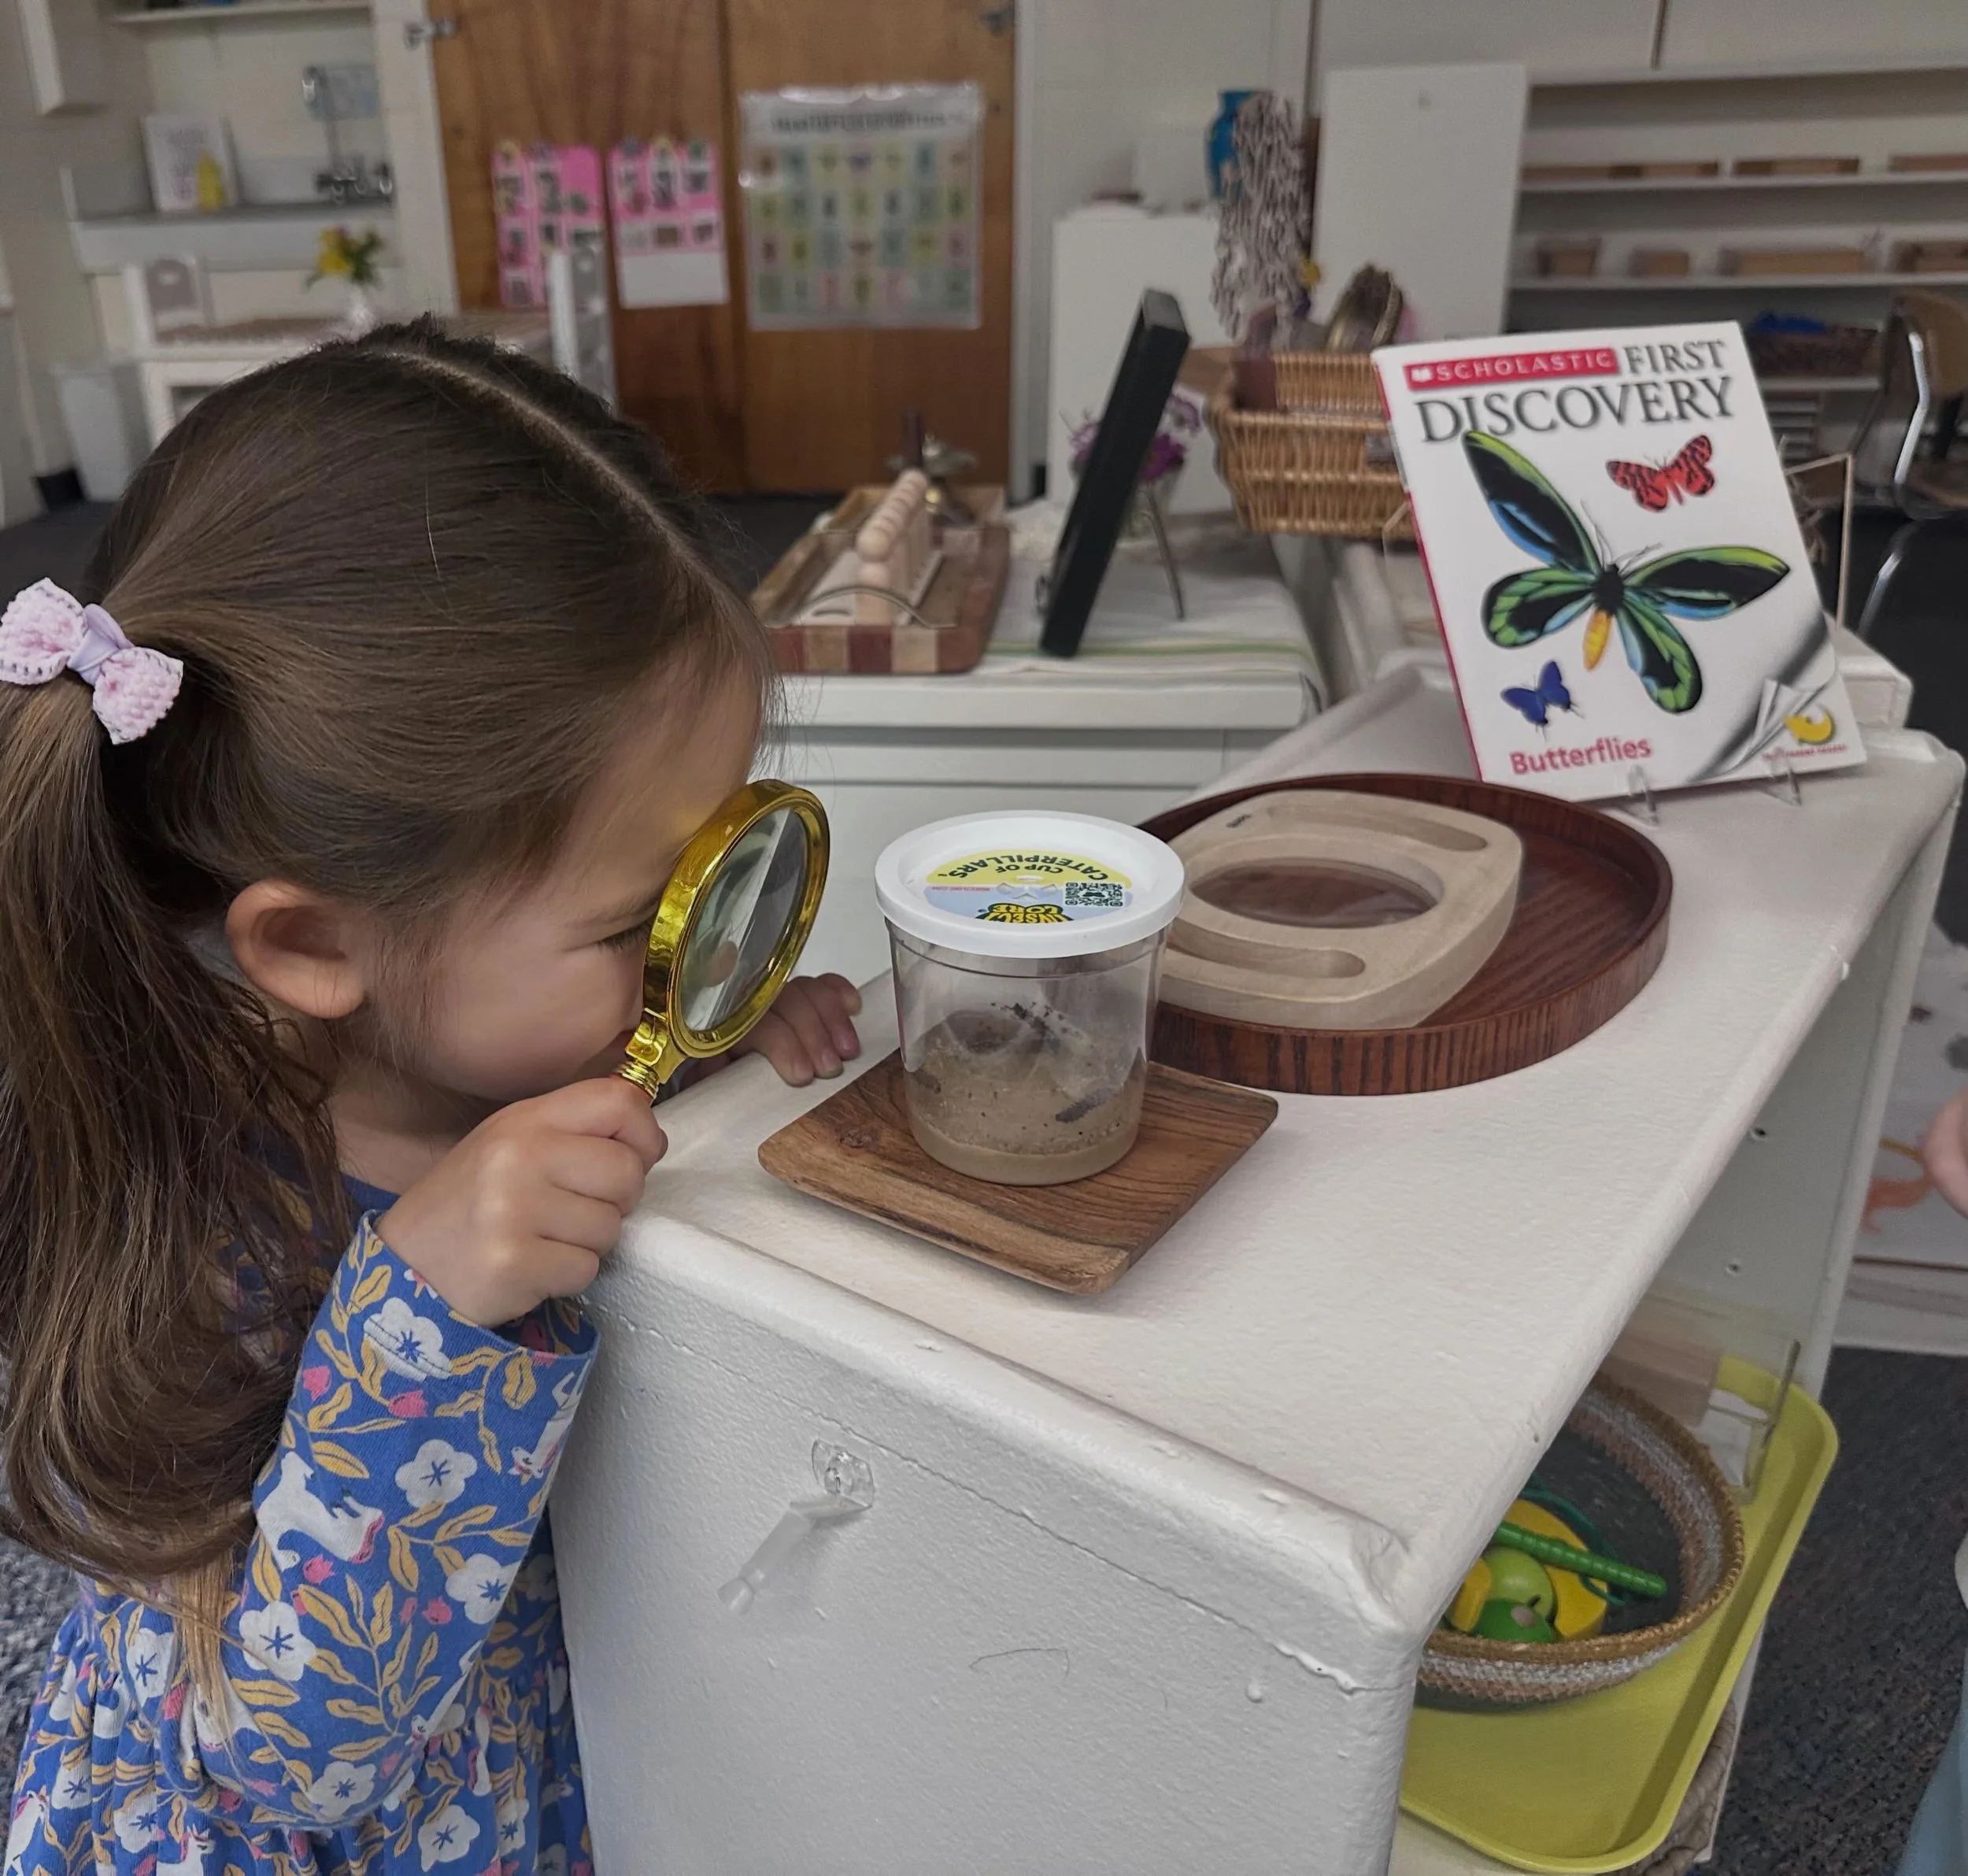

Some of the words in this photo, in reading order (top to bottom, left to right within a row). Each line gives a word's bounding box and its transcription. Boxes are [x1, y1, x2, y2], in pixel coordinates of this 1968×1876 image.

[1436, 350, 1613, 382] SCHOLASTIC
[1624, 340, 1725, 376] FIRST
[1415, 376, 1733, 442] DISCOVERY
[1510, 738, 1652, 775] Butterflies
[996, 864, 1021, 873] OF
[1025, 864, 1063, 874] CUP
[991, 905, 1059, 914] LORE
